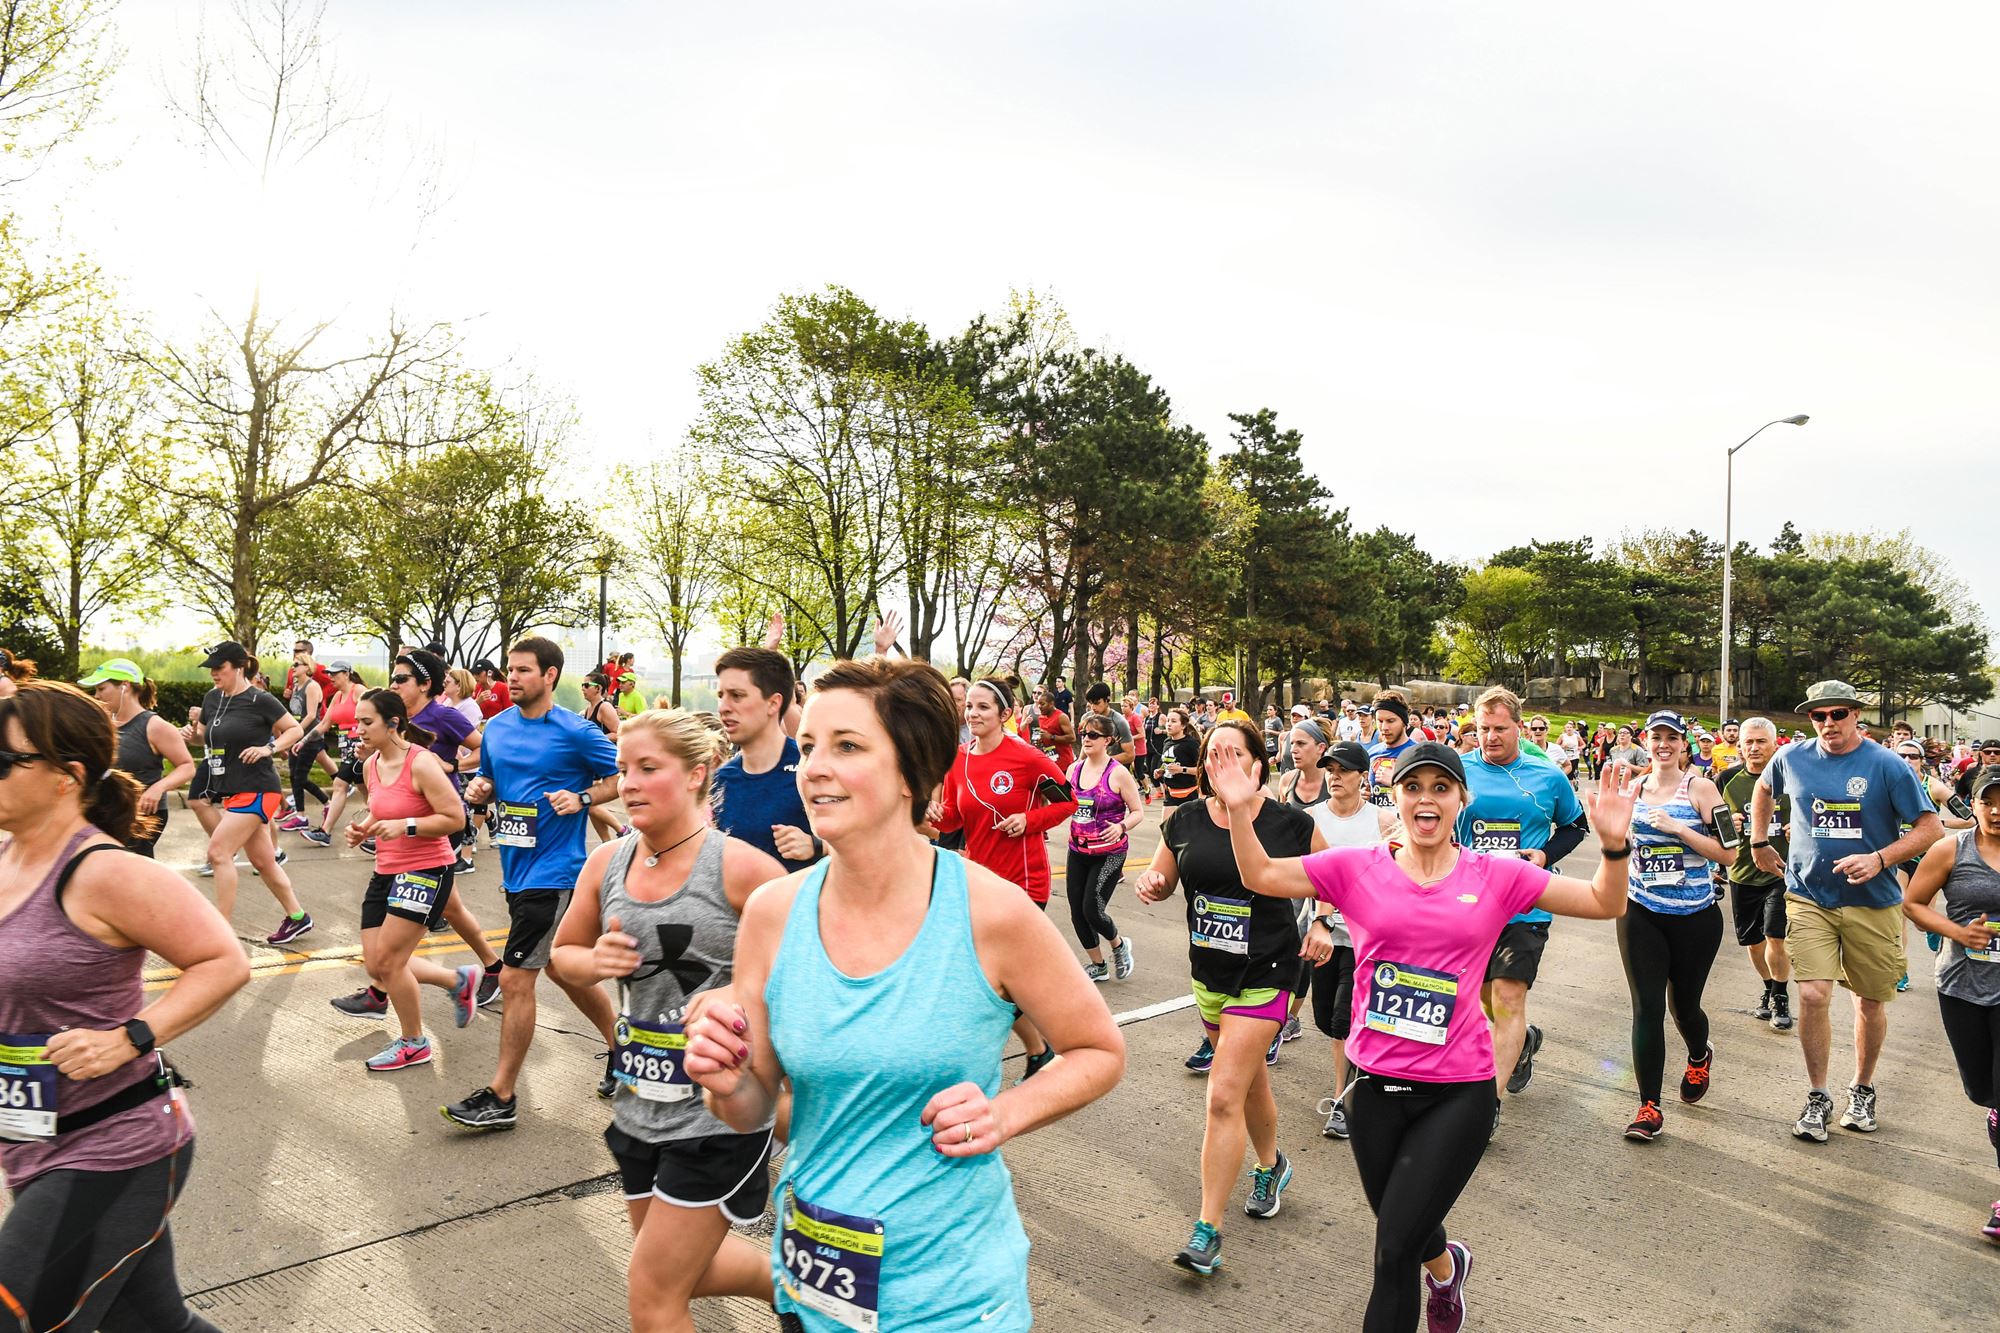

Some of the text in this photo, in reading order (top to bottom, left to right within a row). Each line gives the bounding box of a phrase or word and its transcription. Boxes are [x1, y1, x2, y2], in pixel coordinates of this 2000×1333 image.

[500, 820, 528, 836] 5268
[1818, 815, 1851, 828] 2611
[1475, 836, 1517, 849] 22952
[1645, 859, 1676, 872] 2612
[396, 885, 428, 903] 9410
[1196, 917, 1244, 941] 17704
[1413, 990, 1431, 999] AMY
[1376, 991, 1446, 1026] 12148
[621, 1050, 675, 1083] 9989
[816, 1245, 841, 1260] KARI
[783, 1237, 857, 1300] 9973
